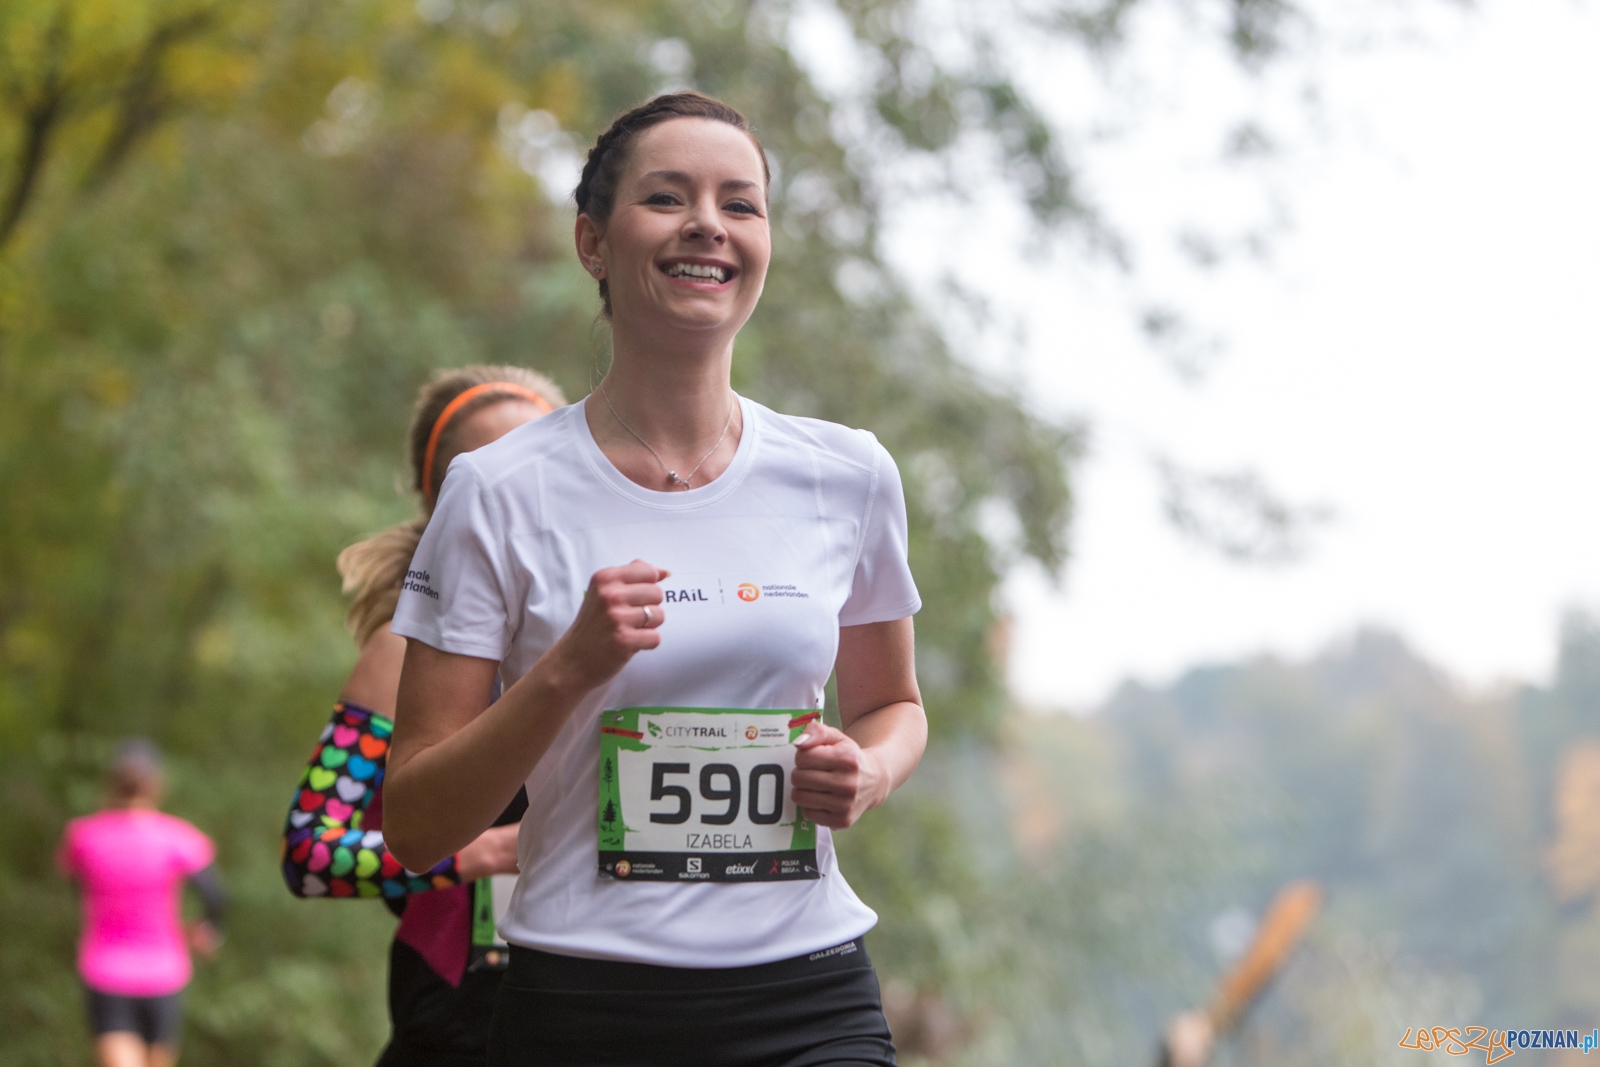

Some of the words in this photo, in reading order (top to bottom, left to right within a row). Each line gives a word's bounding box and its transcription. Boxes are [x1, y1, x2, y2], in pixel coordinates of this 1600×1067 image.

[406, 570, 430, 582] nale
[764, 591, 809, 599] nederlanden
[649, 762, 785, 826] 590
[686, 833, 753, 849] IZABELA
[809, 941, 857, 961] CALZEDONIA
